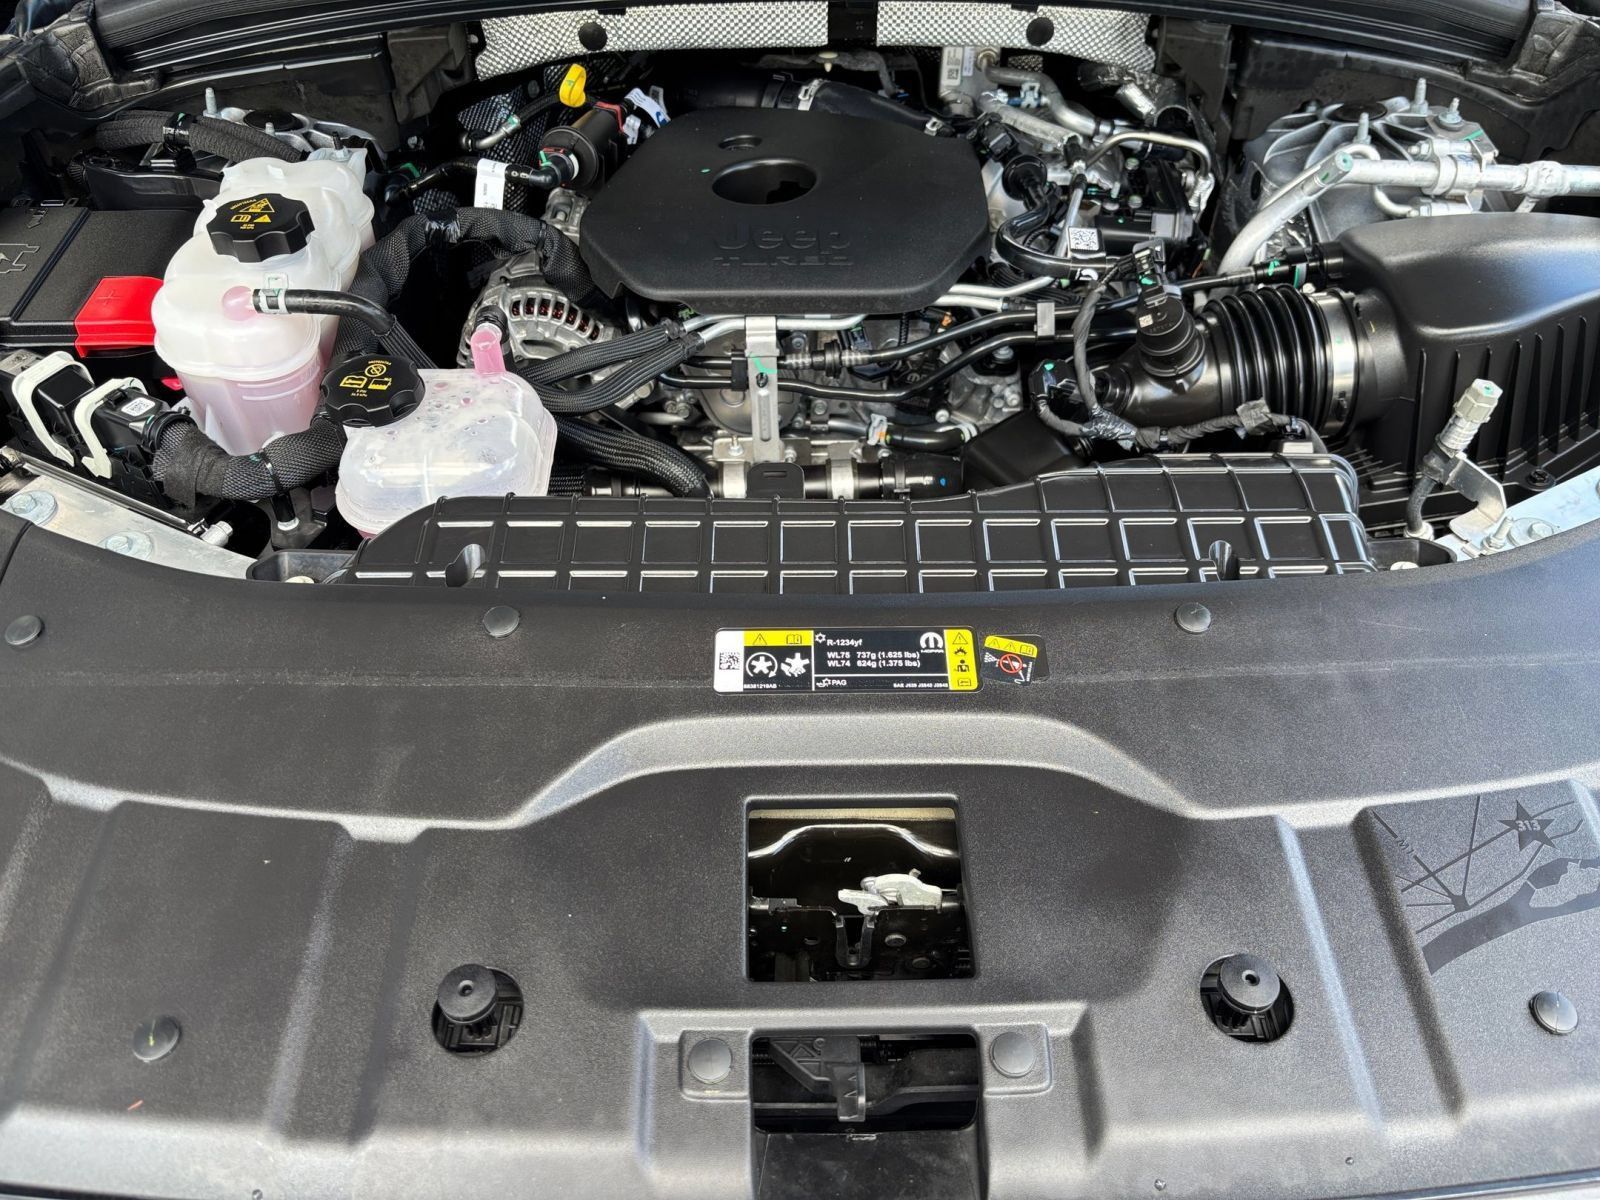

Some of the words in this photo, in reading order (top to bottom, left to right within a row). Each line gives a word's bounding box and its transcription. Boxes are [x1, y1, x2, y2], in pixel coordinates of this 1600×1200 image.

[713, 222, 850, 254] Jeep
[826, 638, 863, 648] R-1234yf
[826, 651, 851, 659] WL75
[856, 651, 877, 660] 737g
[878, 651, 903, 660] (1.625
[904, 651, 920, 660] lbs)
[827, 659, 851, 667] WL74
[856, 659, 877, 668] 624g
[878, 659, 903, 668] (1.375
[904, 659, 921, 668] lbs)
[1515, 819, 1541, 831] 313
